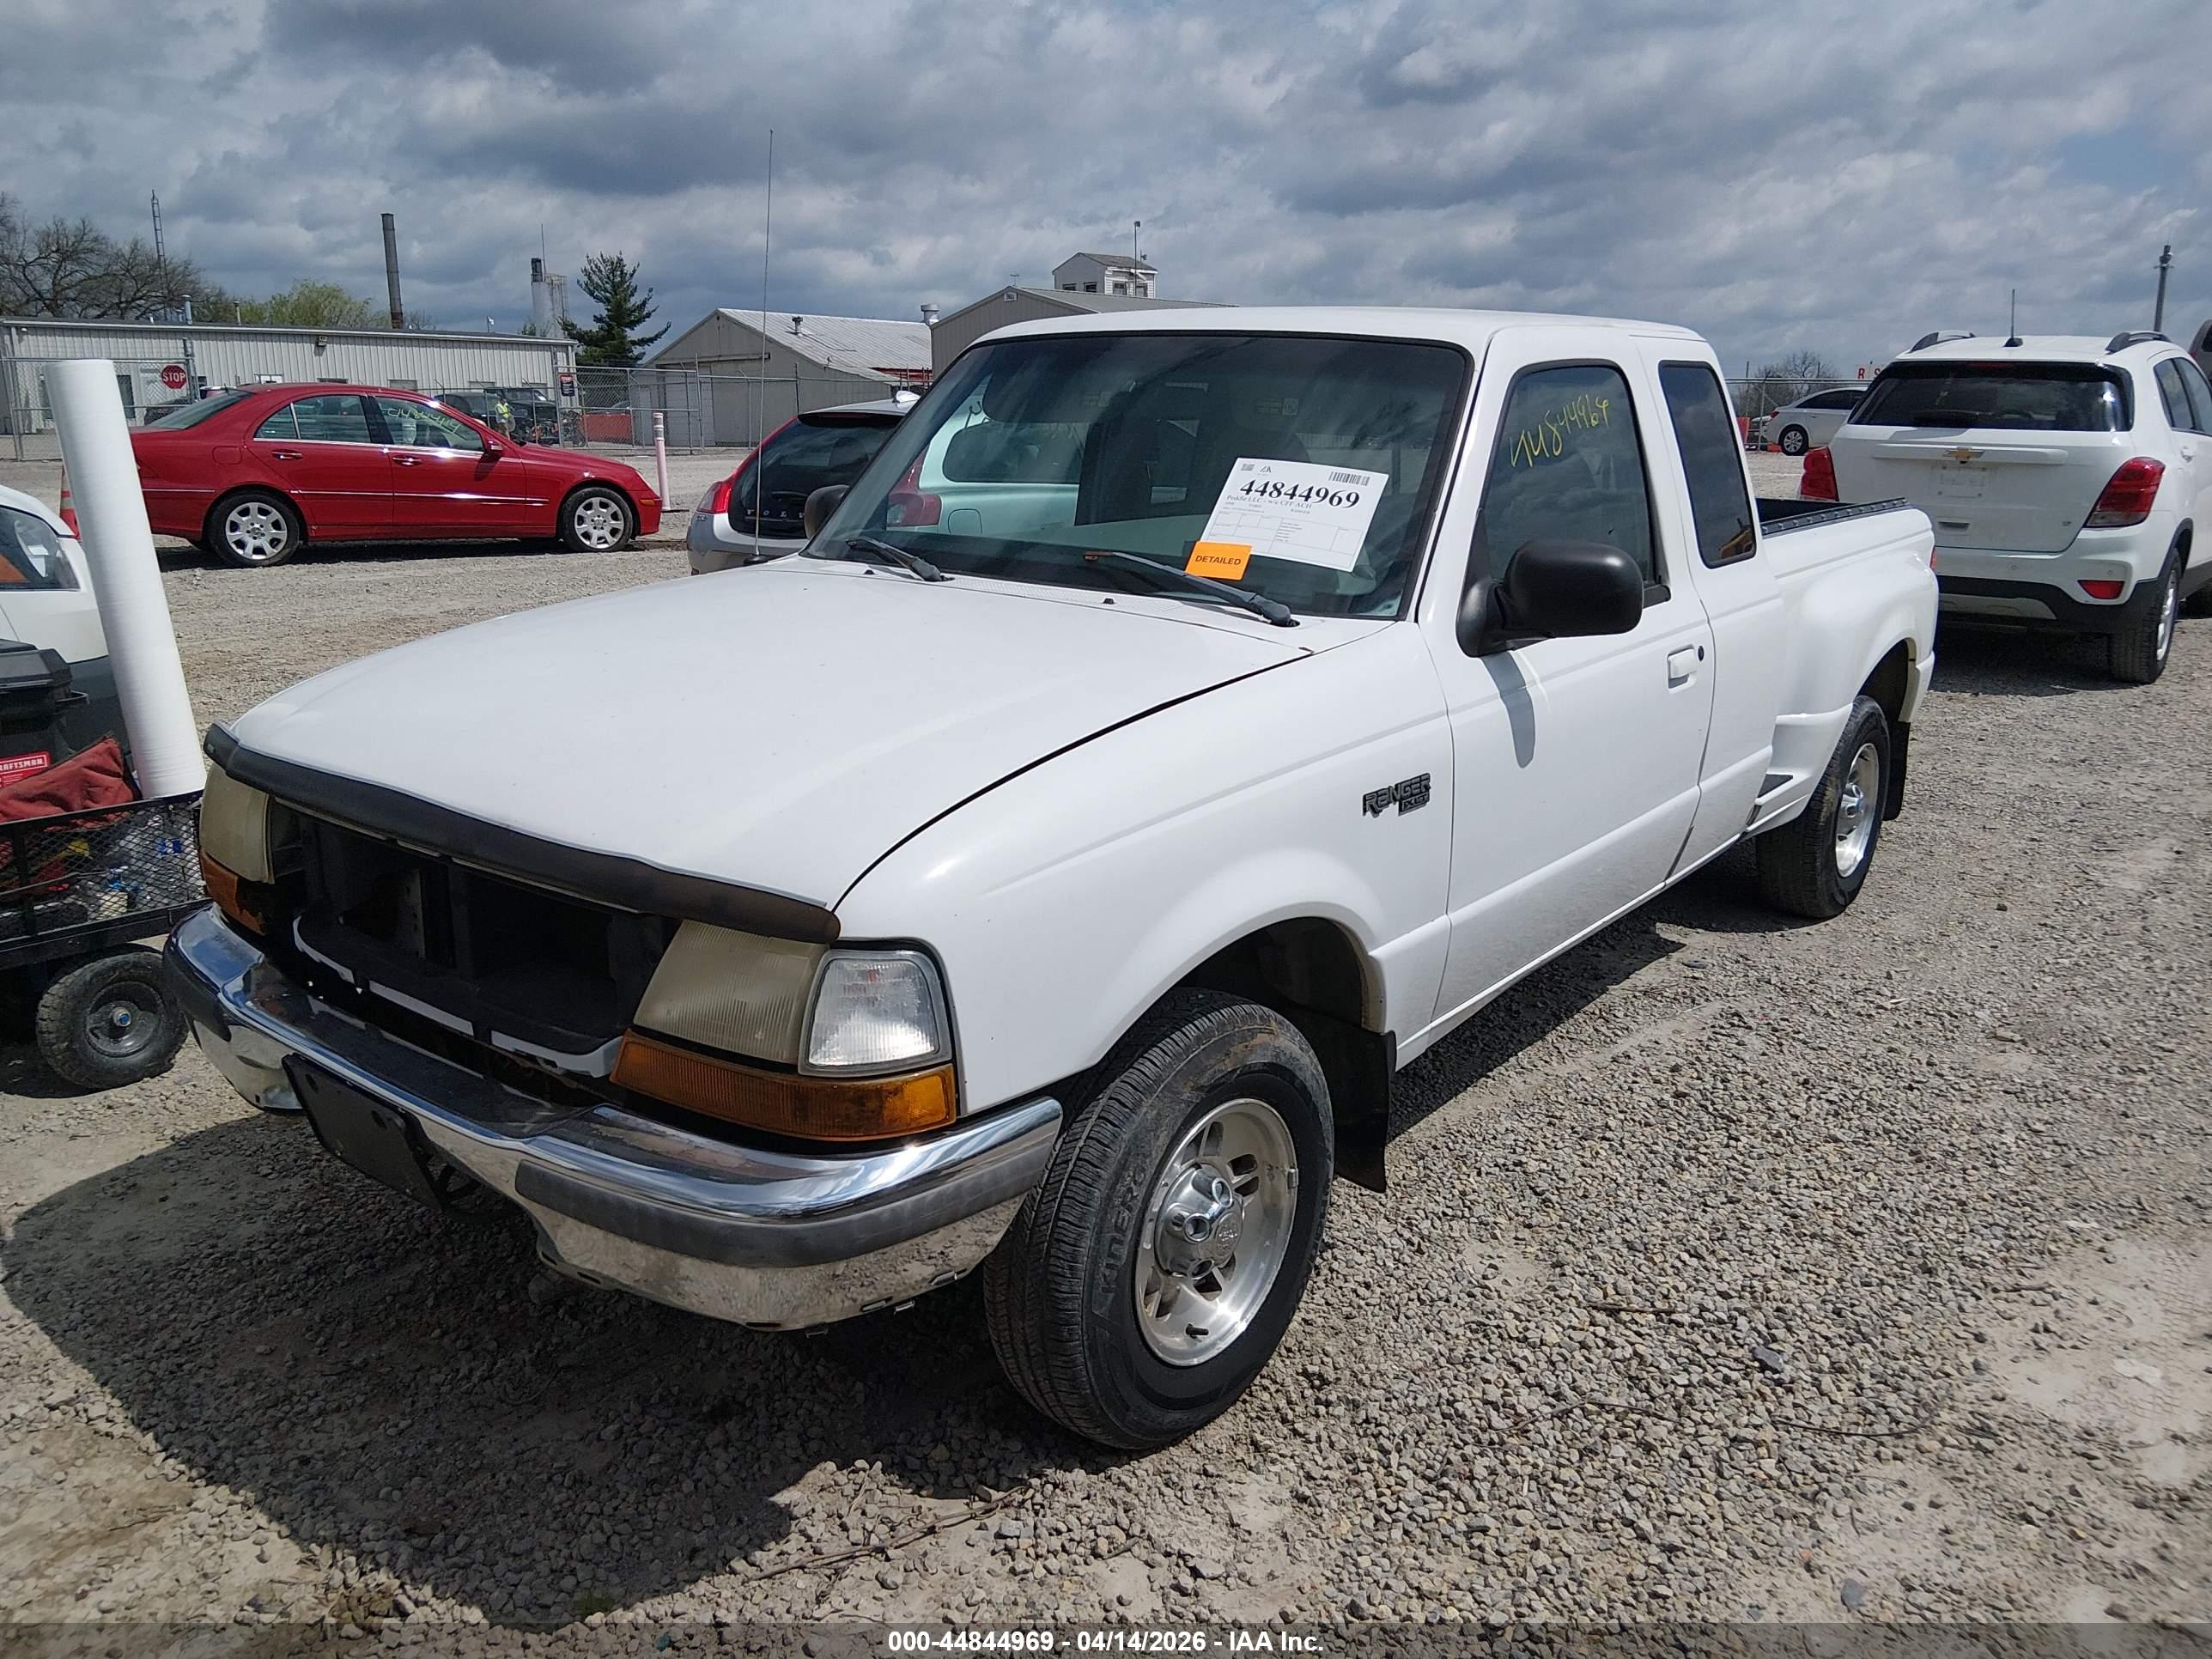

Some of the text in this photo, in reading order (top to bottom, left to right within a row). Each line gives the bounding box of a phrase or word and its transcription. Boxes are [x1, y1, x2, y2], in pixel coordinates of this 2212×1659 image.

[163, 372, 185, 382] STOP
[1510, 394, 1609, 467] 44844969
[1240, 479, 1360, 509] 44844969
[747, 508, 805, 519] VOLV
[1195, 555, 1242, 566] DETAILED
[0, 758, 44, 771] RAFTSMAN
[1363, 773, 1431, 818] RANGER
